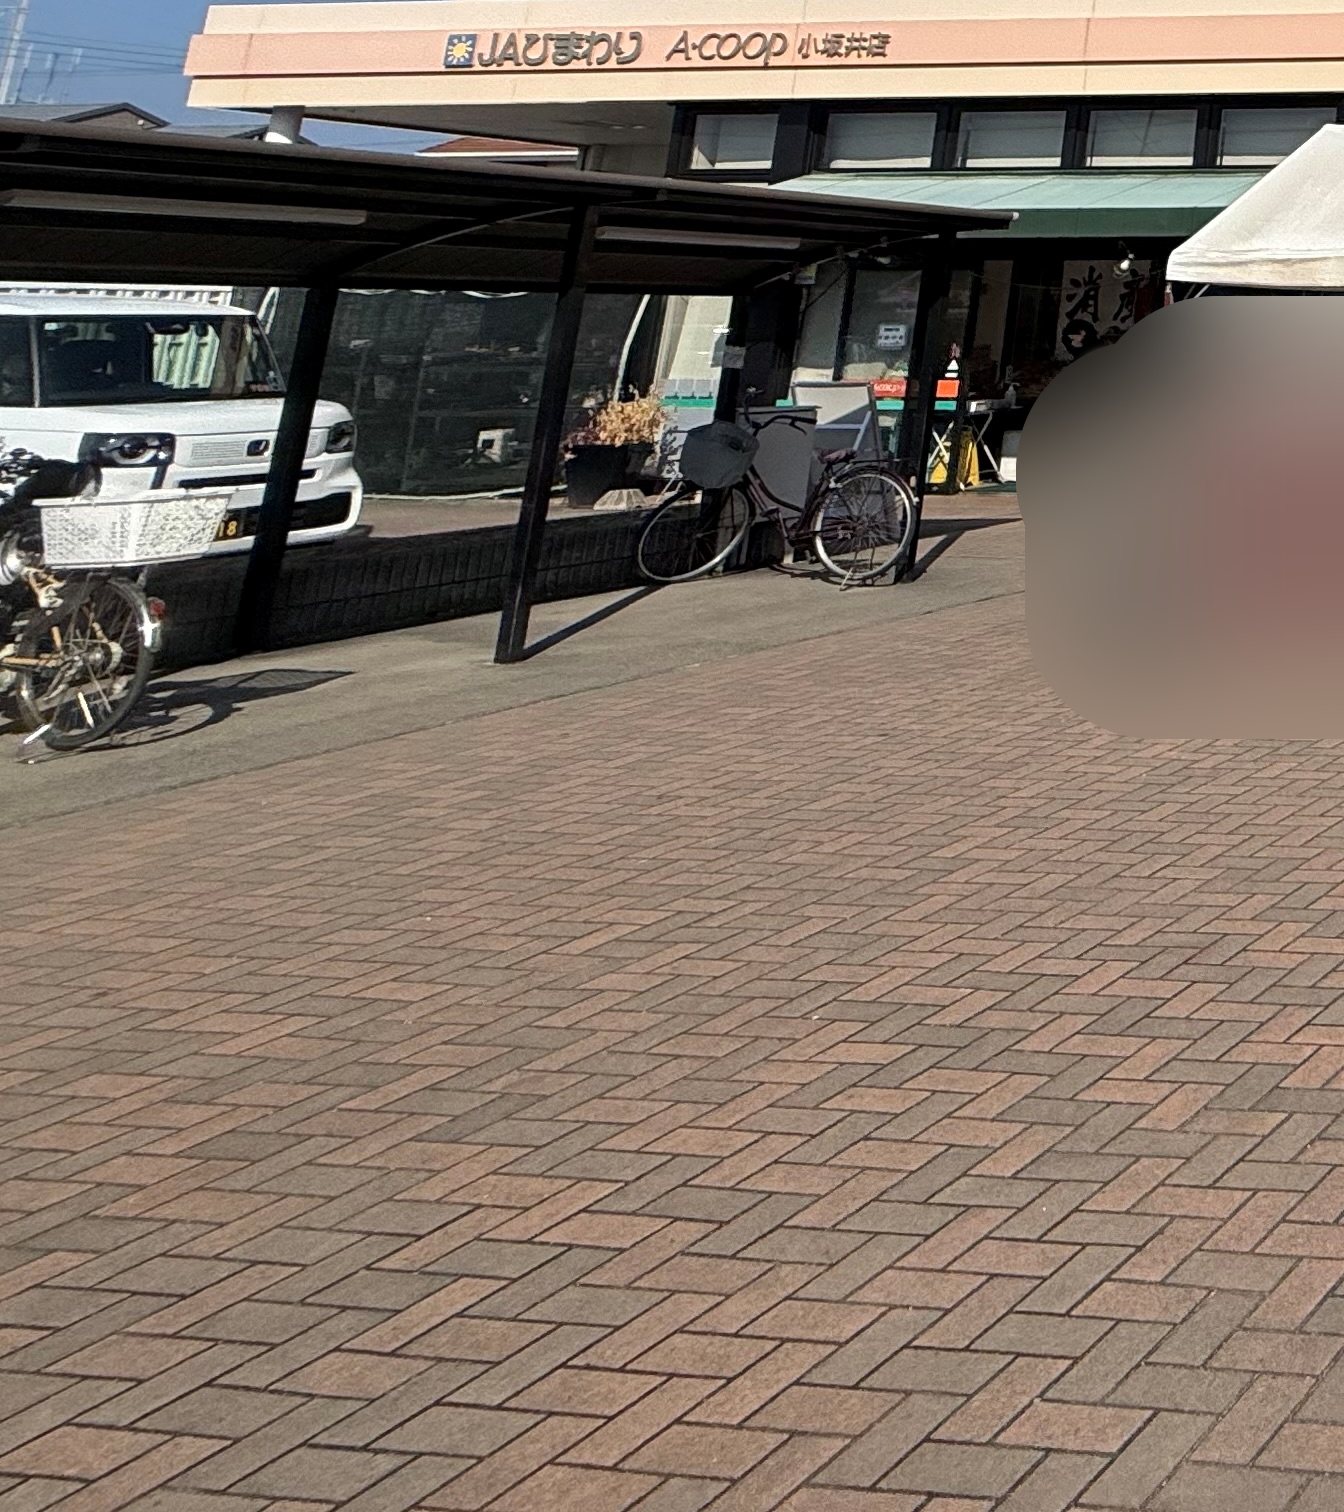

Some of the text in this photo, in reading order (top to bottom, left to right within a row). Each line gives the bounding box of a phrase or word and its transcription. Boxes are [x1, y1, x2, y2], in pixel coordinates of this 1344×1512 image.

[477, 31, 643, 68] JAひまわり
[797, 31, 892, 60] 小坂井店
